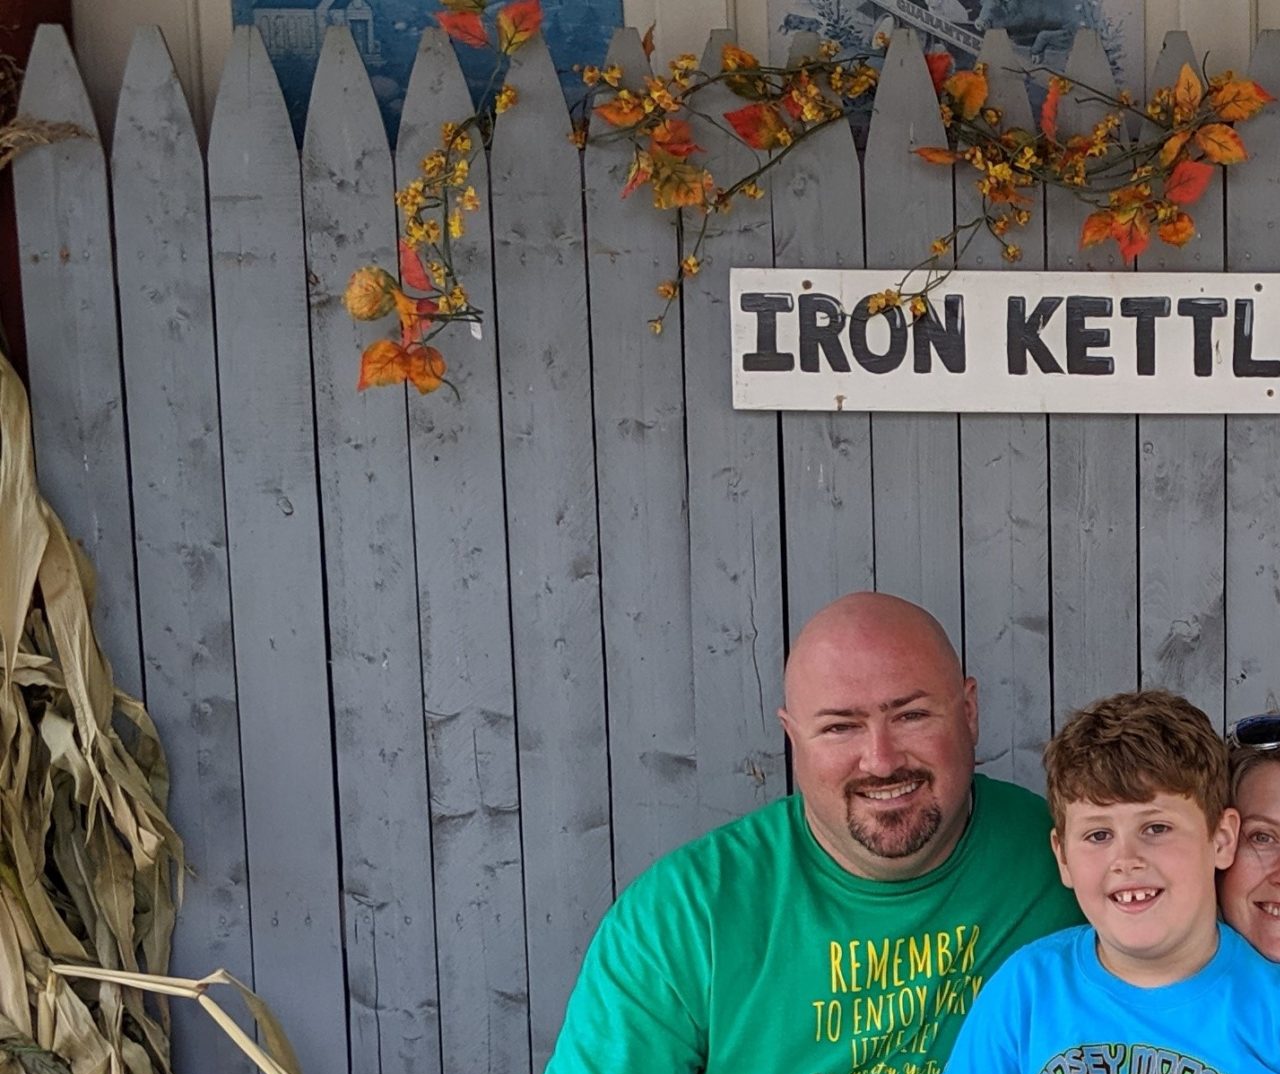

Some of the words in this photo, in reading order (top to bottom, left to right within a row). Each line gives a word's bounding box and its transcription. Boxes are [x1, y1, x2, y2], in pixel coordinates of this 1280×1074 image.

[740, 292, 967, 375] IRON
[829, 925, 980, 993] REMEMBER
[812, 1000, 843, 1042] TO
[853, 985, 928, 1035] ENJOY
